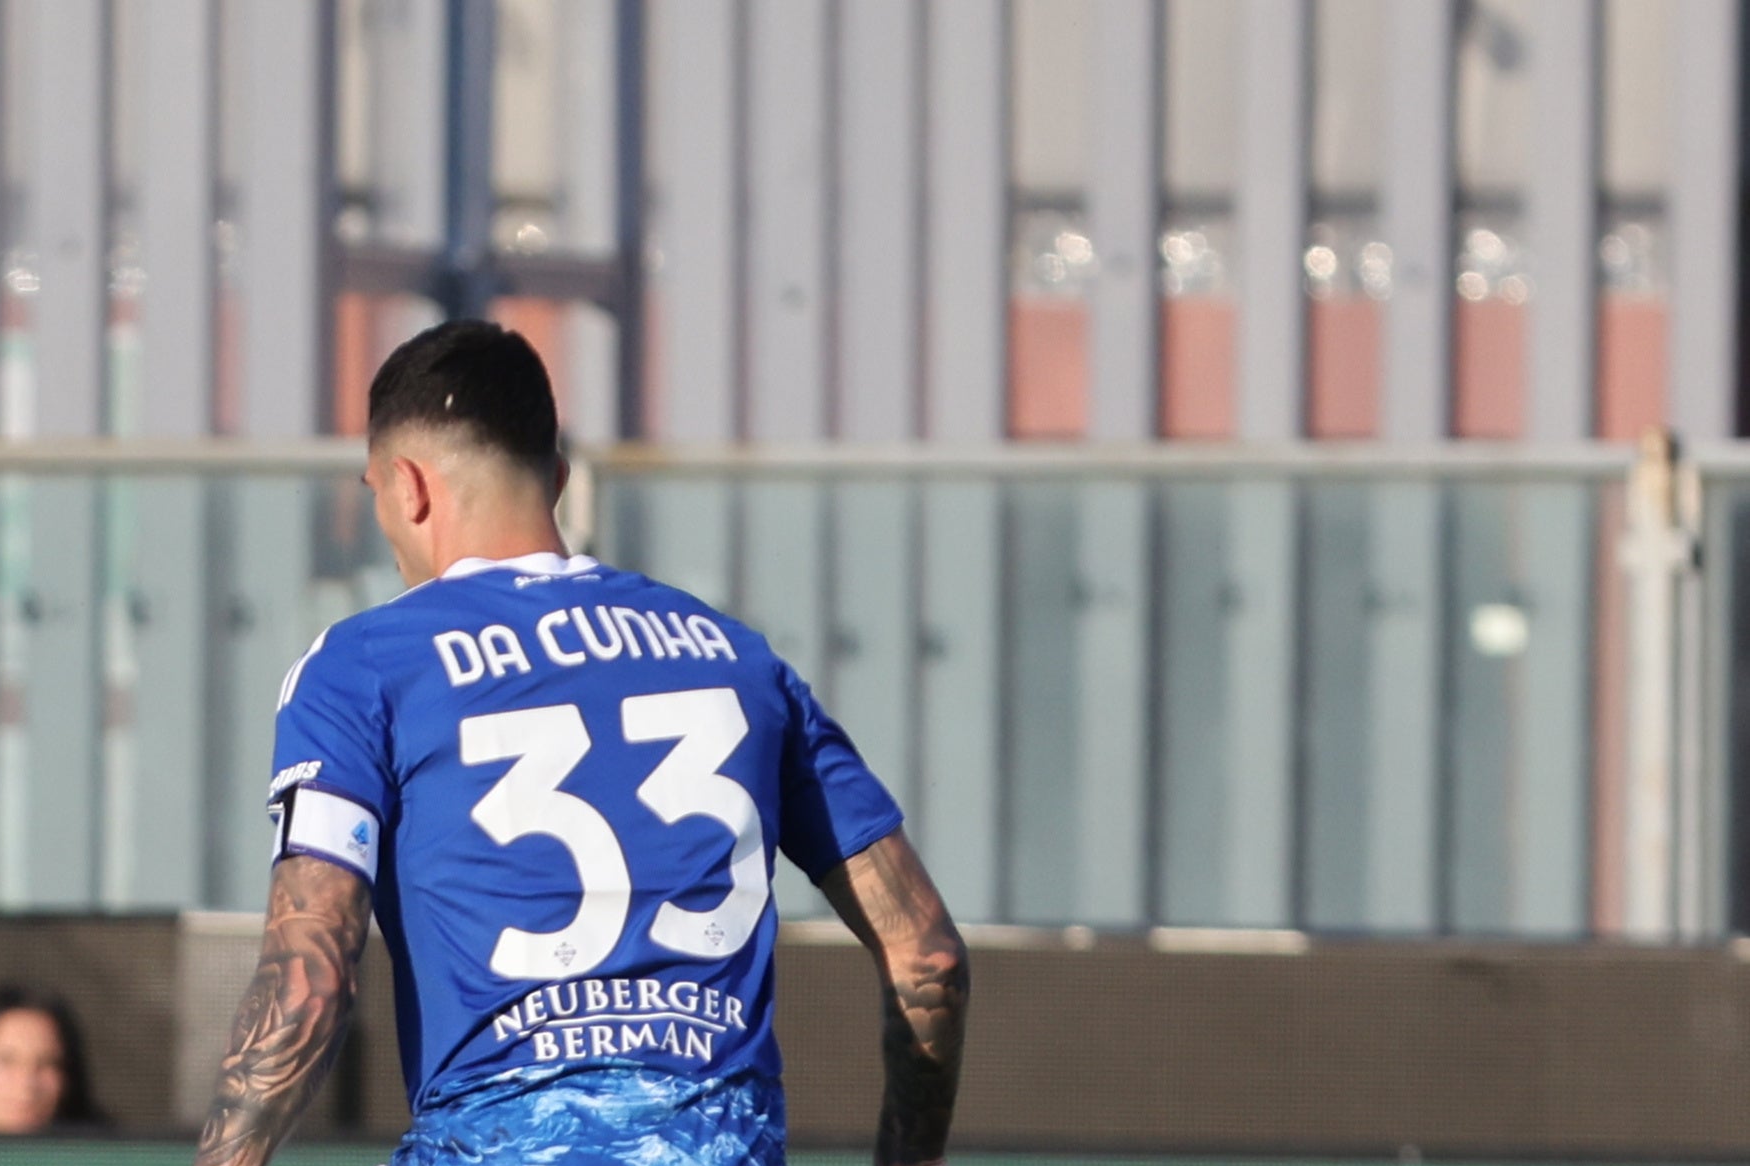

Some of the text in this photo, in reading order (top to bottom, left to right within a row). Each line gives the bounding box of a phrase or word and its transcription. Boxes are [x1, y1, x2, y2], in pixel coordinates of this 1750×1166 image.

[433, 605, 738, 687] DA CUNHA
[458, 687, 770, 980] 33
[493, 978, 747, 1041] NEUBERGER
[533, 1021, 713, 1063] BERMAN
